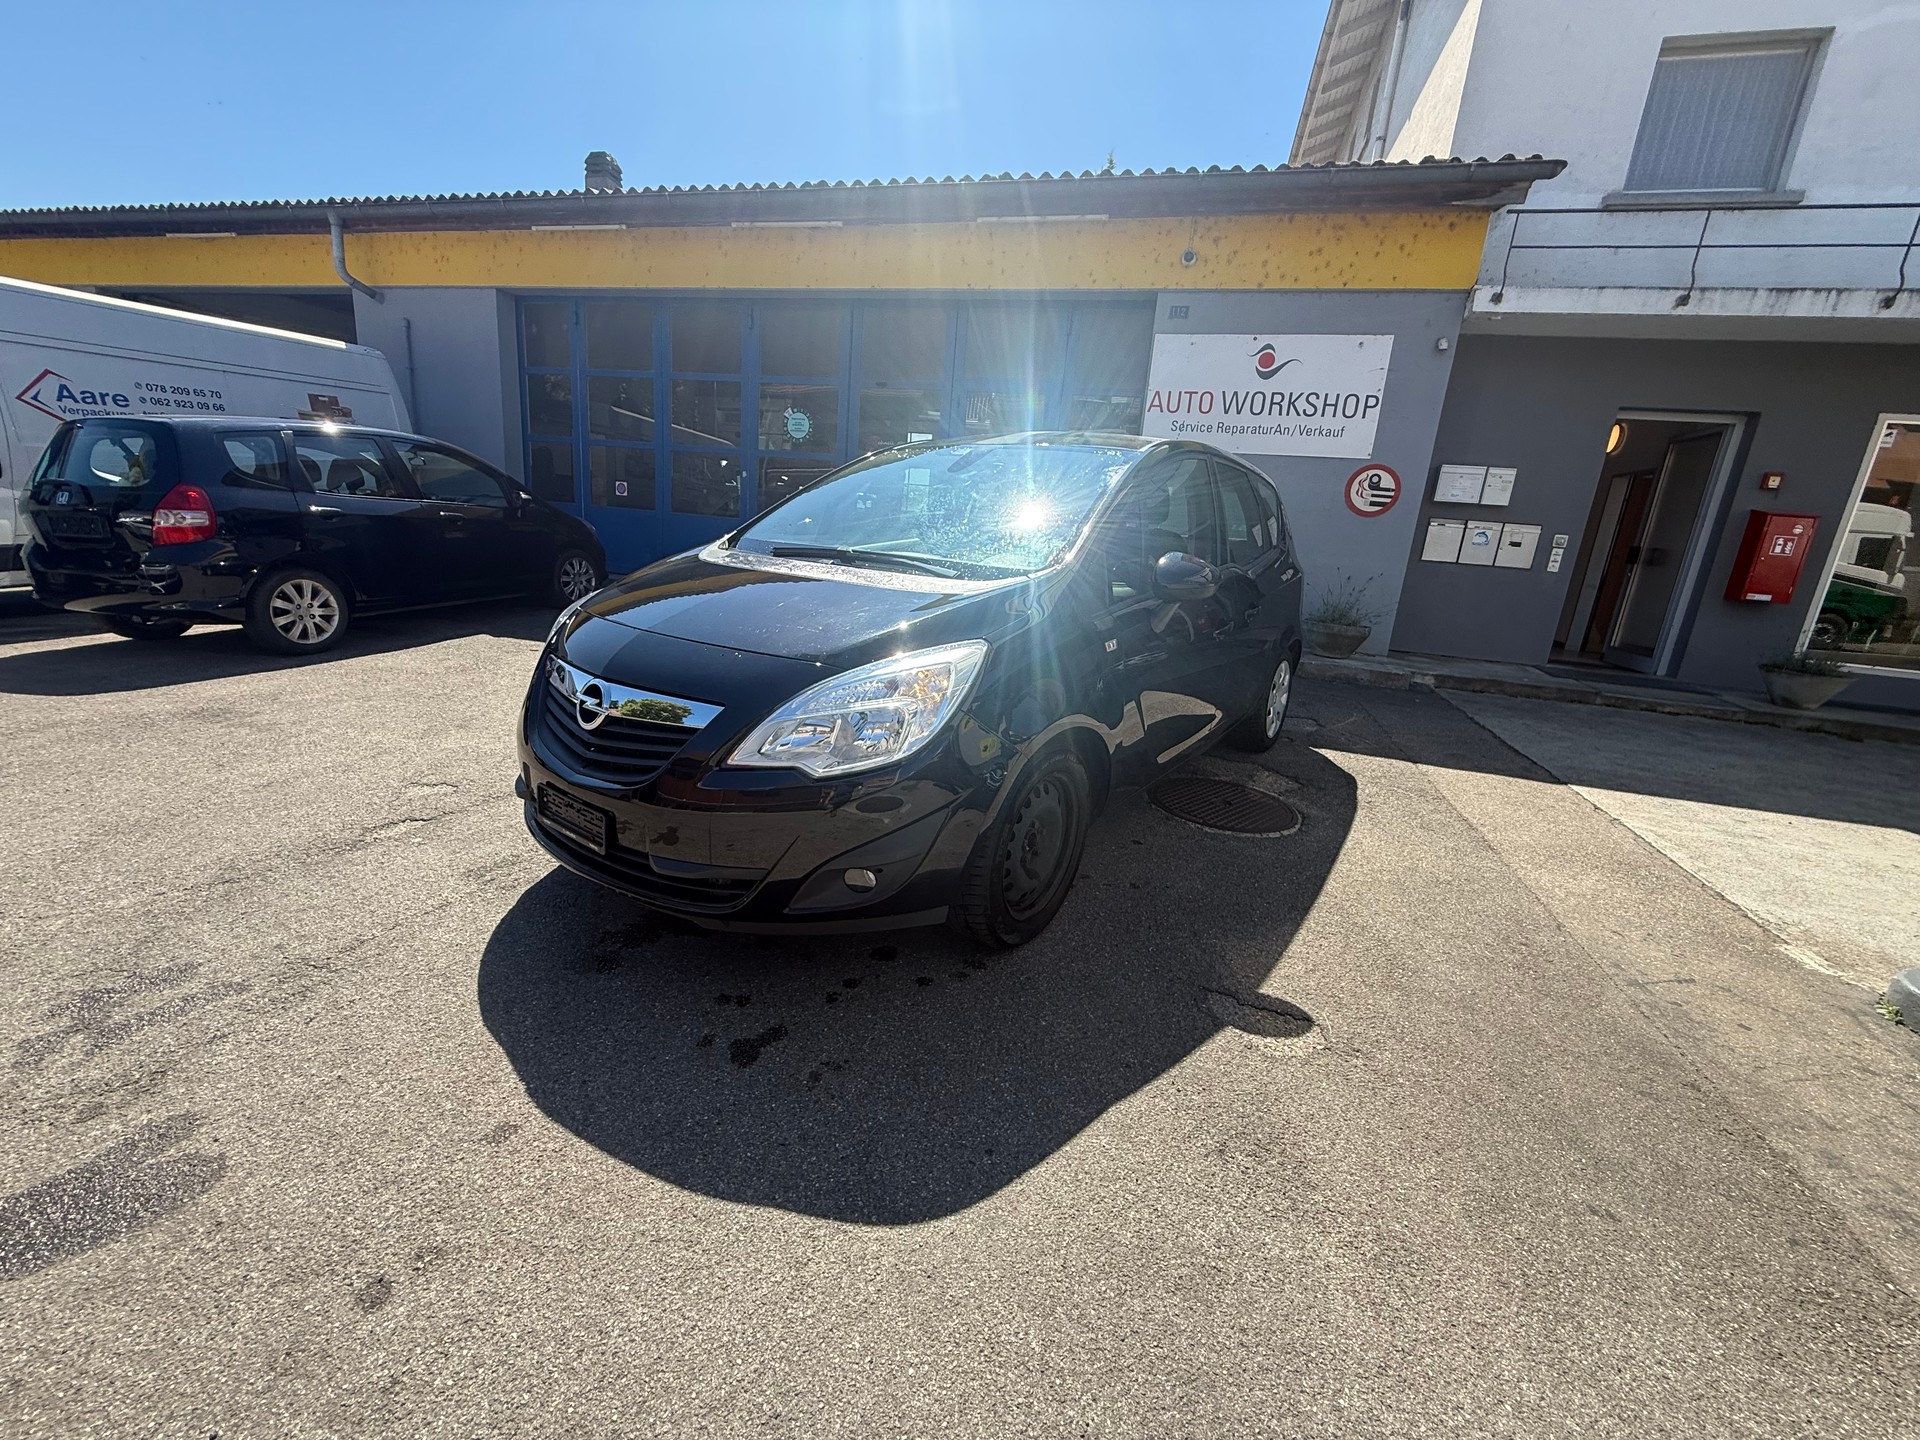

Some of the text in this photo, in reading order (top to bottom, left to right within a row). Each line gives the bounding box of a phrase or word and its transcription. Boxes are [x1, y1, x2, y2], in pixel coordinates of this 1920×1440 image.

[56, 383, 130, 408] Aare
[145, 383, 222, 399] 078 209 65 70
[150, 397, 226, 412] 062 923 09 66
[1147, 390, 1380, 419] AUTO WORKSHOP
[1171, 420, 1213, 433] Service
